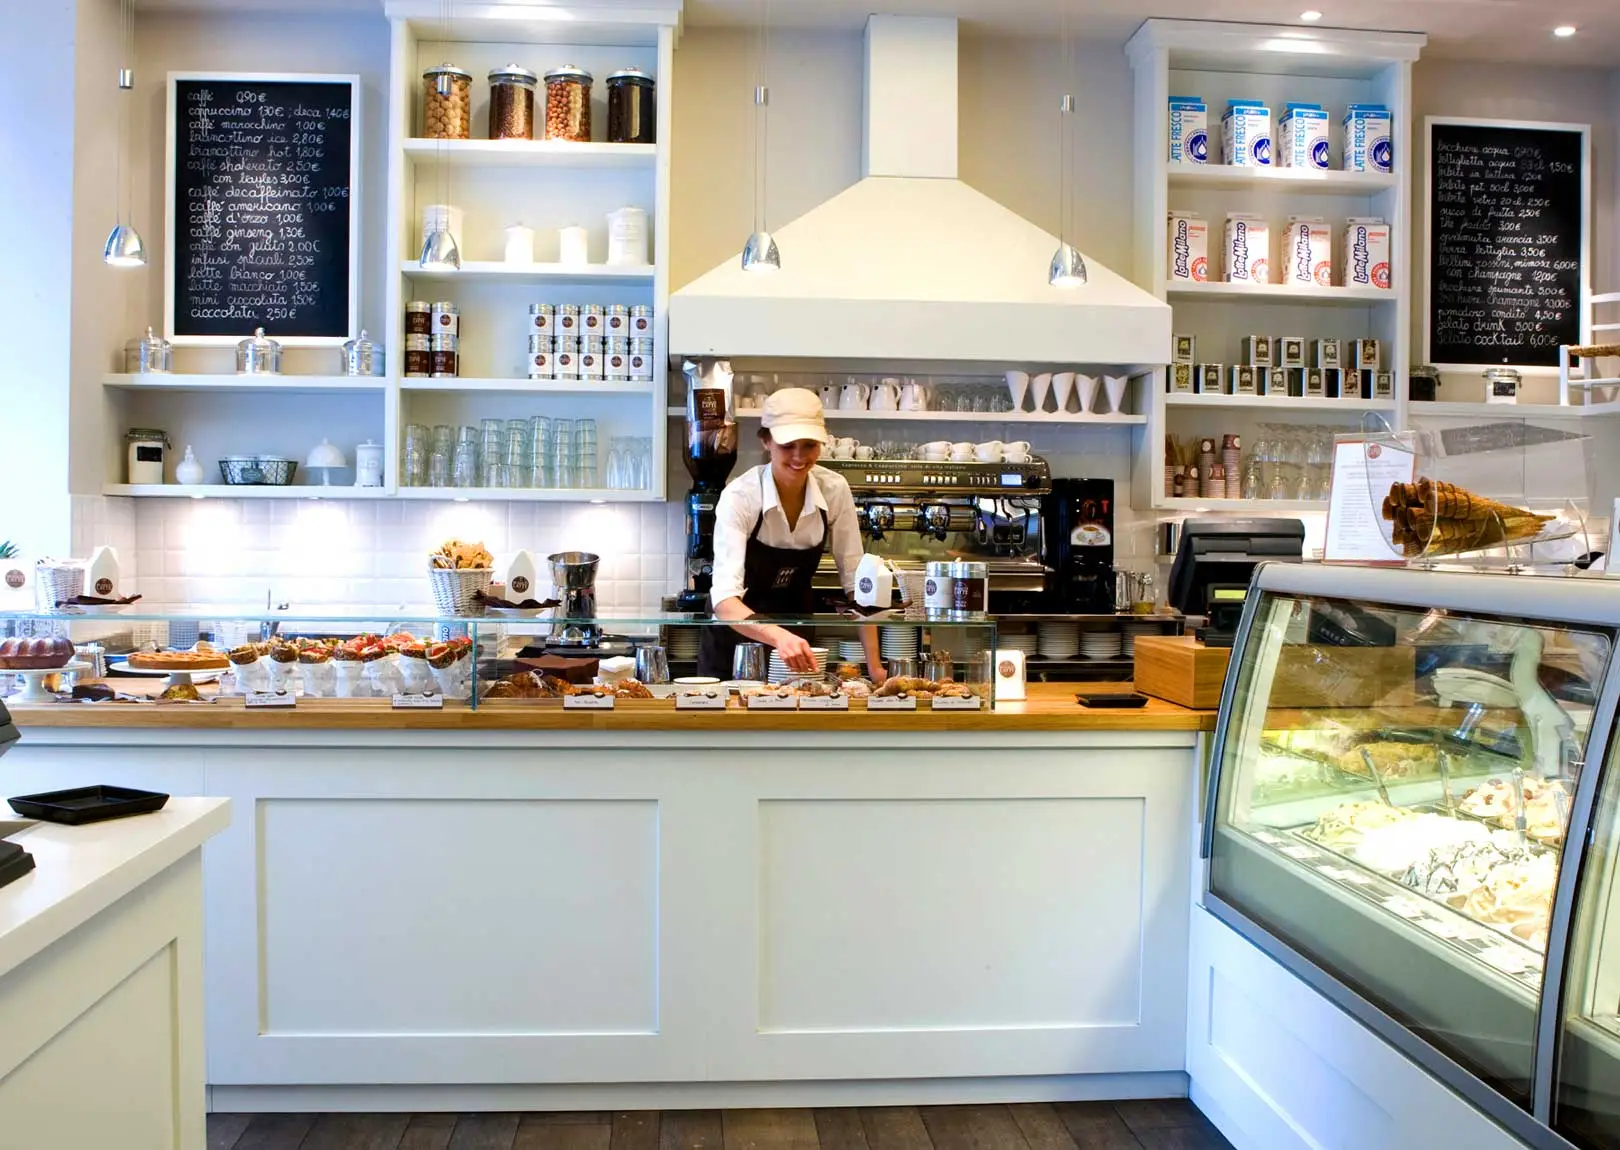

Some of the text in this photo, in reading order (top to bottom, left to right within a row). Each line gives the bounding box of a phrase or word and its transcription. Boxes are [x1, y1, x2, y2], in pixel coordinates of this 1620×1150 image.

[188, 105, 252, 120] cappuccino
[294, 104, 321, 117] deca
[221, 118, 286, 130] marocchino
[1171, 111, 1182, 139] FRESCO
[1235, 115, 1246, 144] FRESCO
[1294, 118, 1305, 147] FRESCO
[268, 146, 292, 158] hot
[1354, 118, 1365, 172] LATTE FRESCO
[1482, 146, 1510, 158] acqua
[1488, 158, 1516, 171] acqua
[213, 174, 233, 184] con
[224, 184, 319, 204] decaffeinato
[228, 201, 301, 212] americano
[227, 225, 274, 246] ginseng
[1496, 235, 1533, 244] arancia
[1174, 220, 1189, 278] LatteMilano
[1233, 222, 1248, 279] LatteMilano
[1296, 225, 1311, 281] LatteMilano
[1353, 227, 1368, 283] LatteMilano
[188, 266, 223, 279] latte
[230, 266, 276, 280] bianco
[1468, 268, 1523, 287] champagne
[191, 294, 220, 305] mini
[190, 306, 257, 319] cioccolata
[1491, 307, 1526, 319] condito
